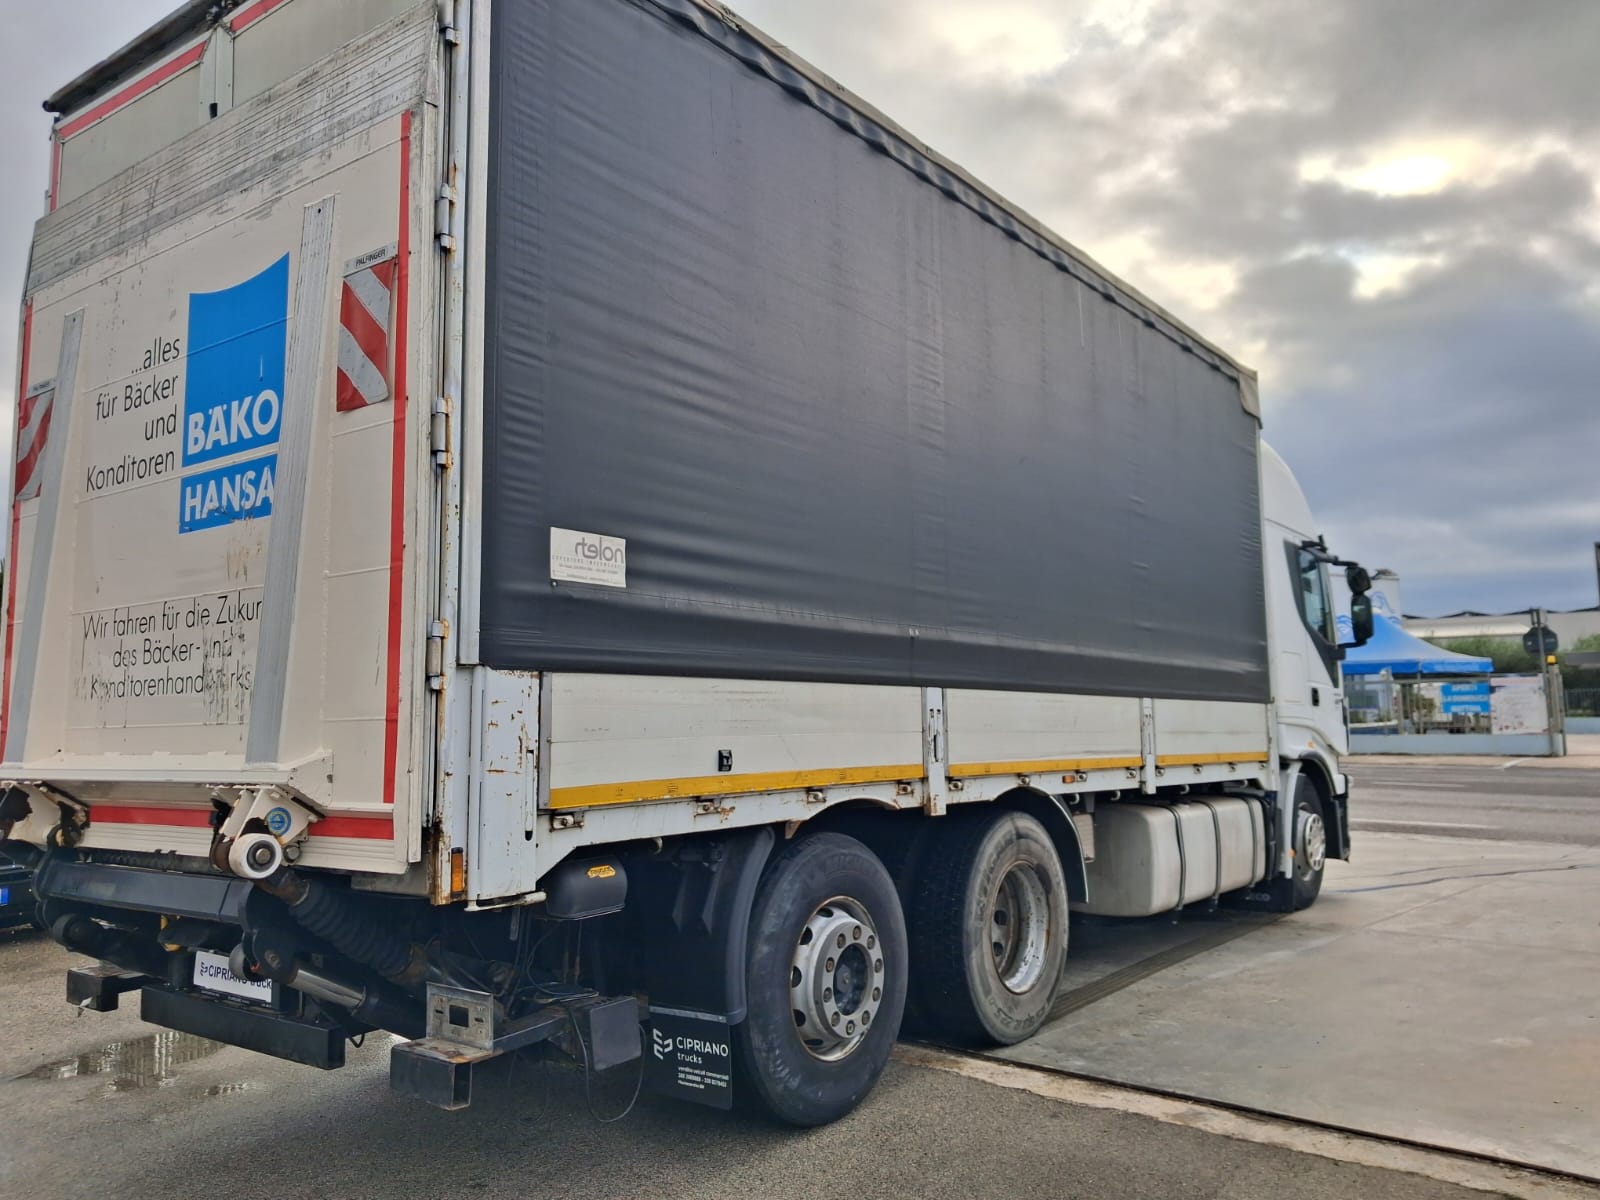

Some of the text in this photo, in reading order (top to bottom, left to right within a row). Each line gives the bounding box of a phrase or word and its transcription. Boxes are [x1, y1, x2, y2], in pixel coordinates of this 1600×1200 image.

[96, 374, 179, 421] für Bäcker
[144, 403, 177, 441] und
[187, 389, 280, 456] BÄKO
[86, 450, 175, 493] Konditoren
[184, 464, 274, 522] HANSA
[83, 613, 108, 640] Wir
[113, 606, 156, 637] fahren
[162, 601, 180, 631] für
[185, 597, 210, 629] die
[113, 639, 137, 668] des
[143, 633, 201, 666] Bäcker-
[676, 1036, 729, 1057] CIPRIANO
[677, 1052, 702, 1064] trucks
